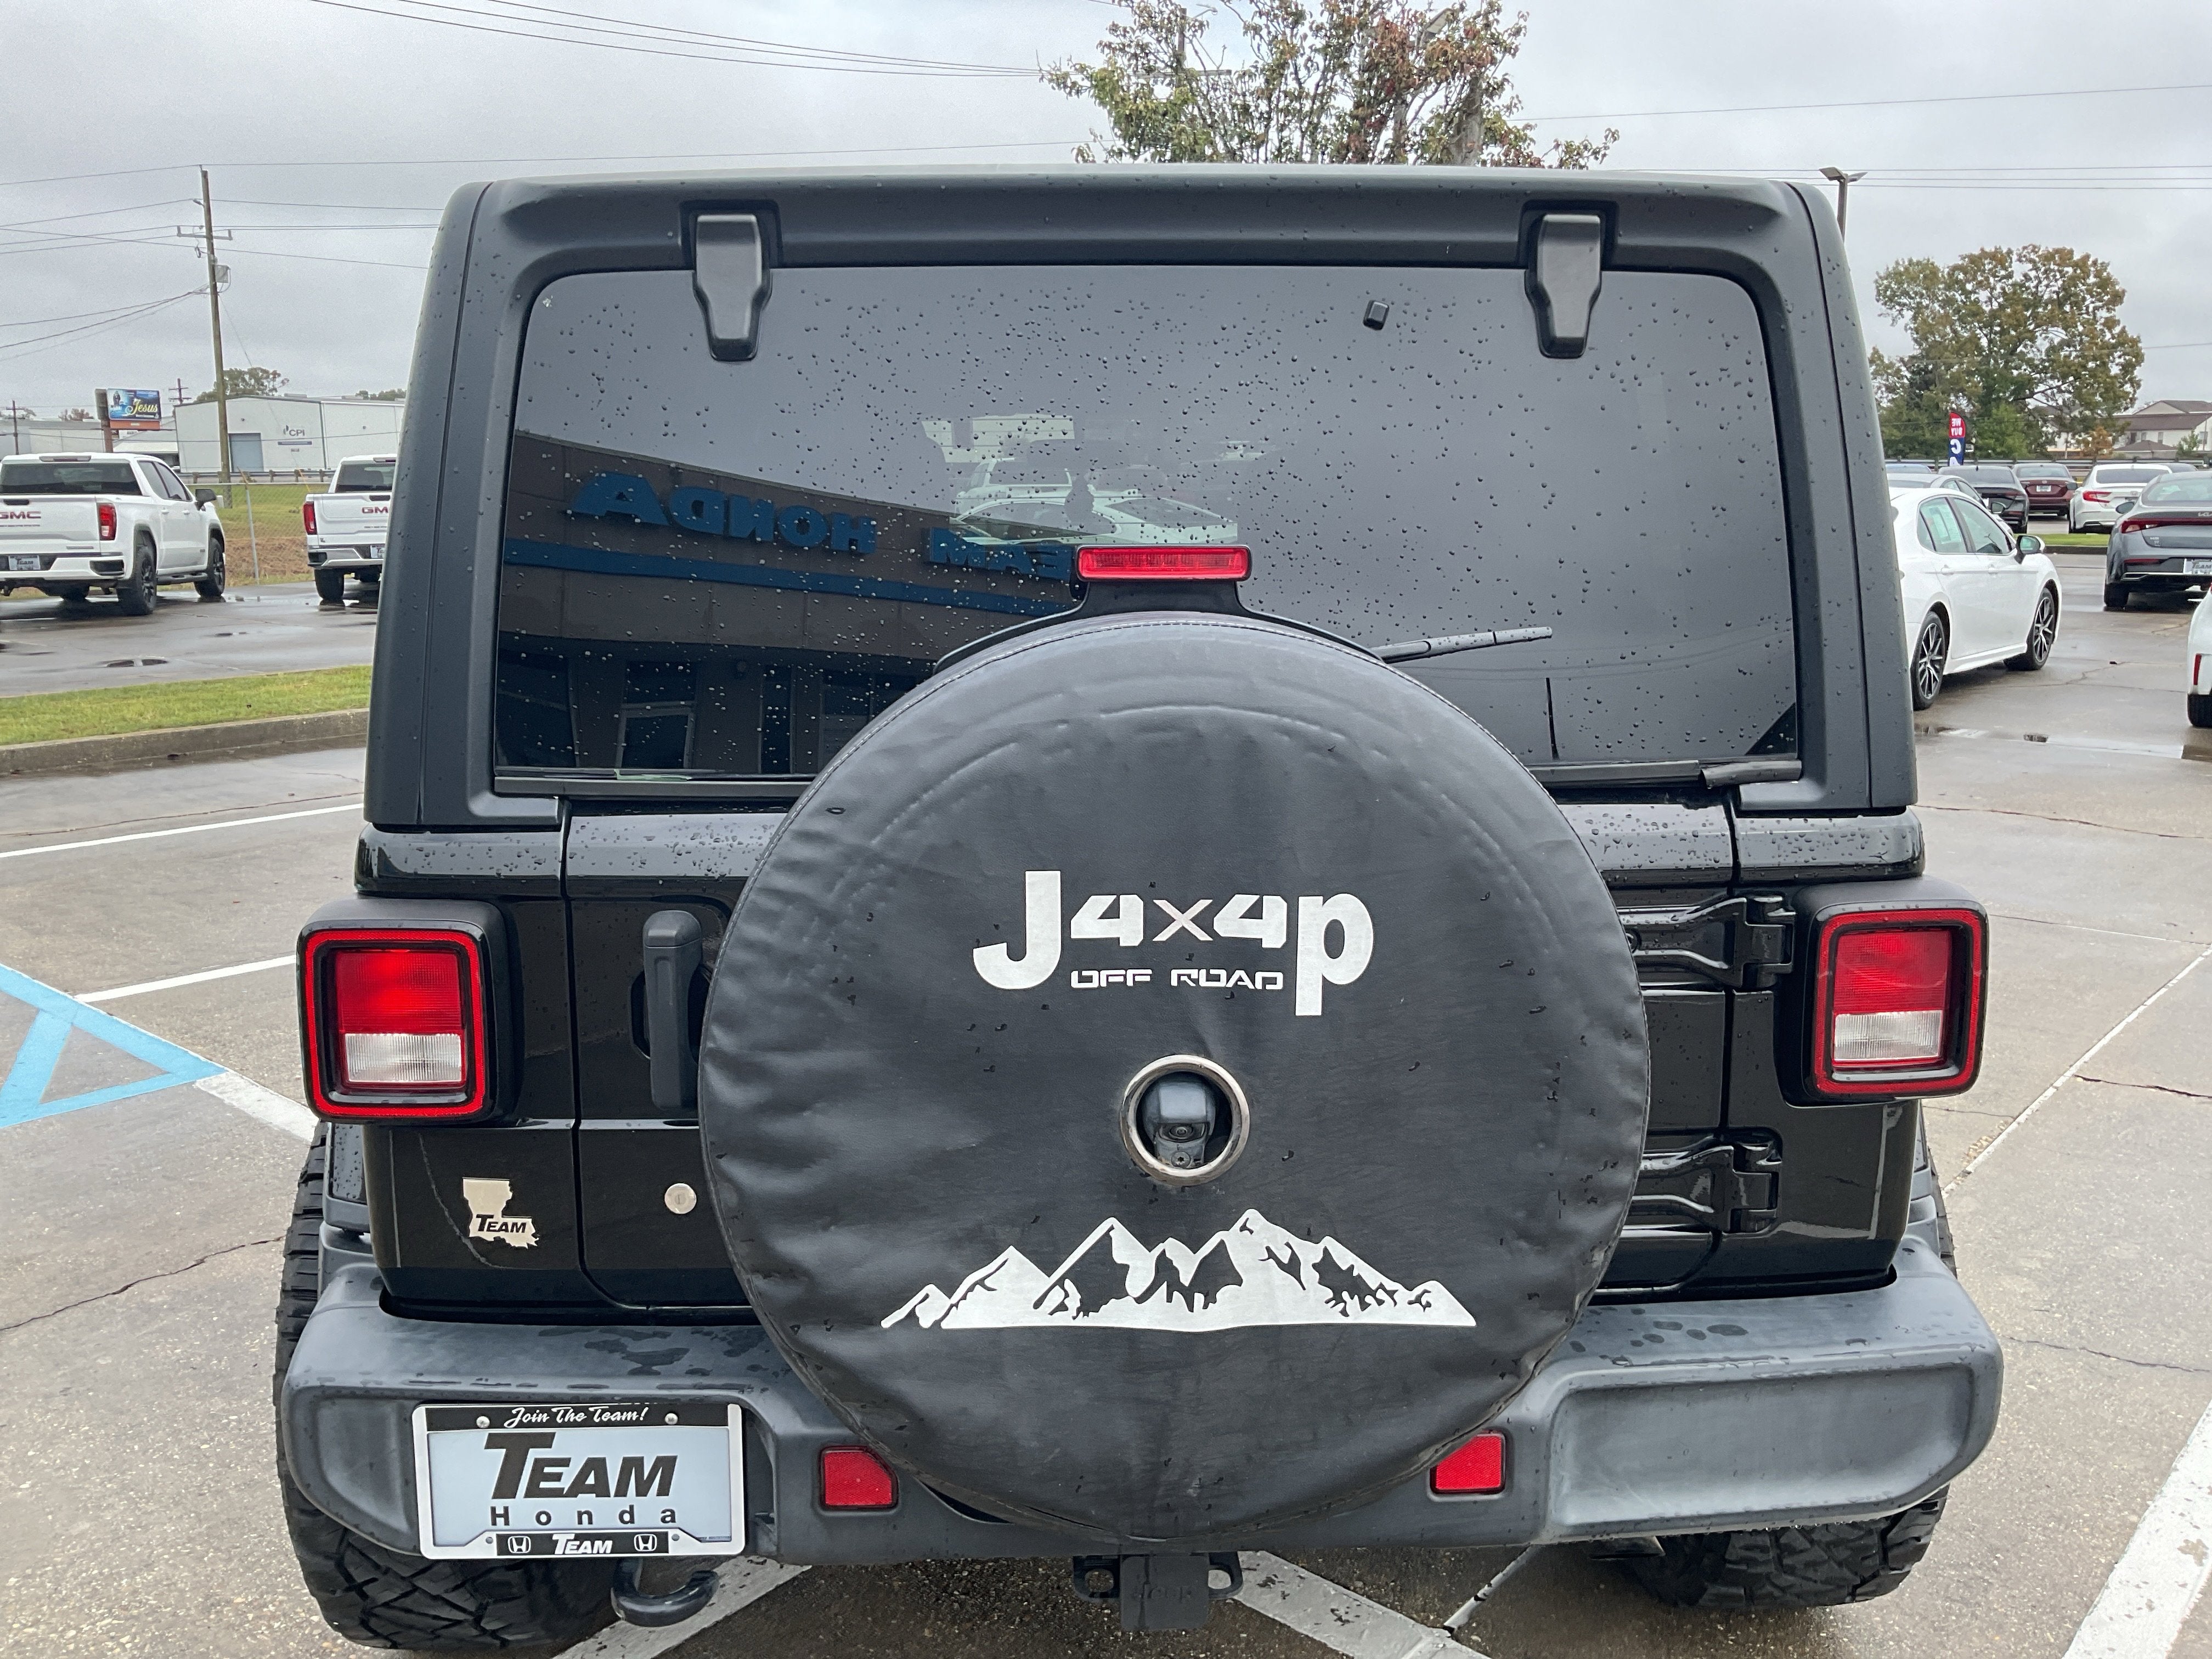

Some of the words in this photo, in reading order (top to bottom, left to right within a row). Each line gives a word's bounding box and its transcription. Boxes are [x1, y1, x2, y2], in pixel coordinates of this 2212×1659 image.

[125, 398, 158, 415] Jesus
[1070, 969, 1153, 988] OFF
[1170, 968, 1284, 990] ROAD
[476, 1214, 527, 1234] TEAM
[503, 1406, 550, 1429] Join
[551, 1406, 587, 1424] The
[588, 1406, 650, 1423] Team!
[484, 1431, 678, 1499] TEAM
[490, 1504, 677, 1526] Honda
[552, 1533, 613, 1555] TEAM
